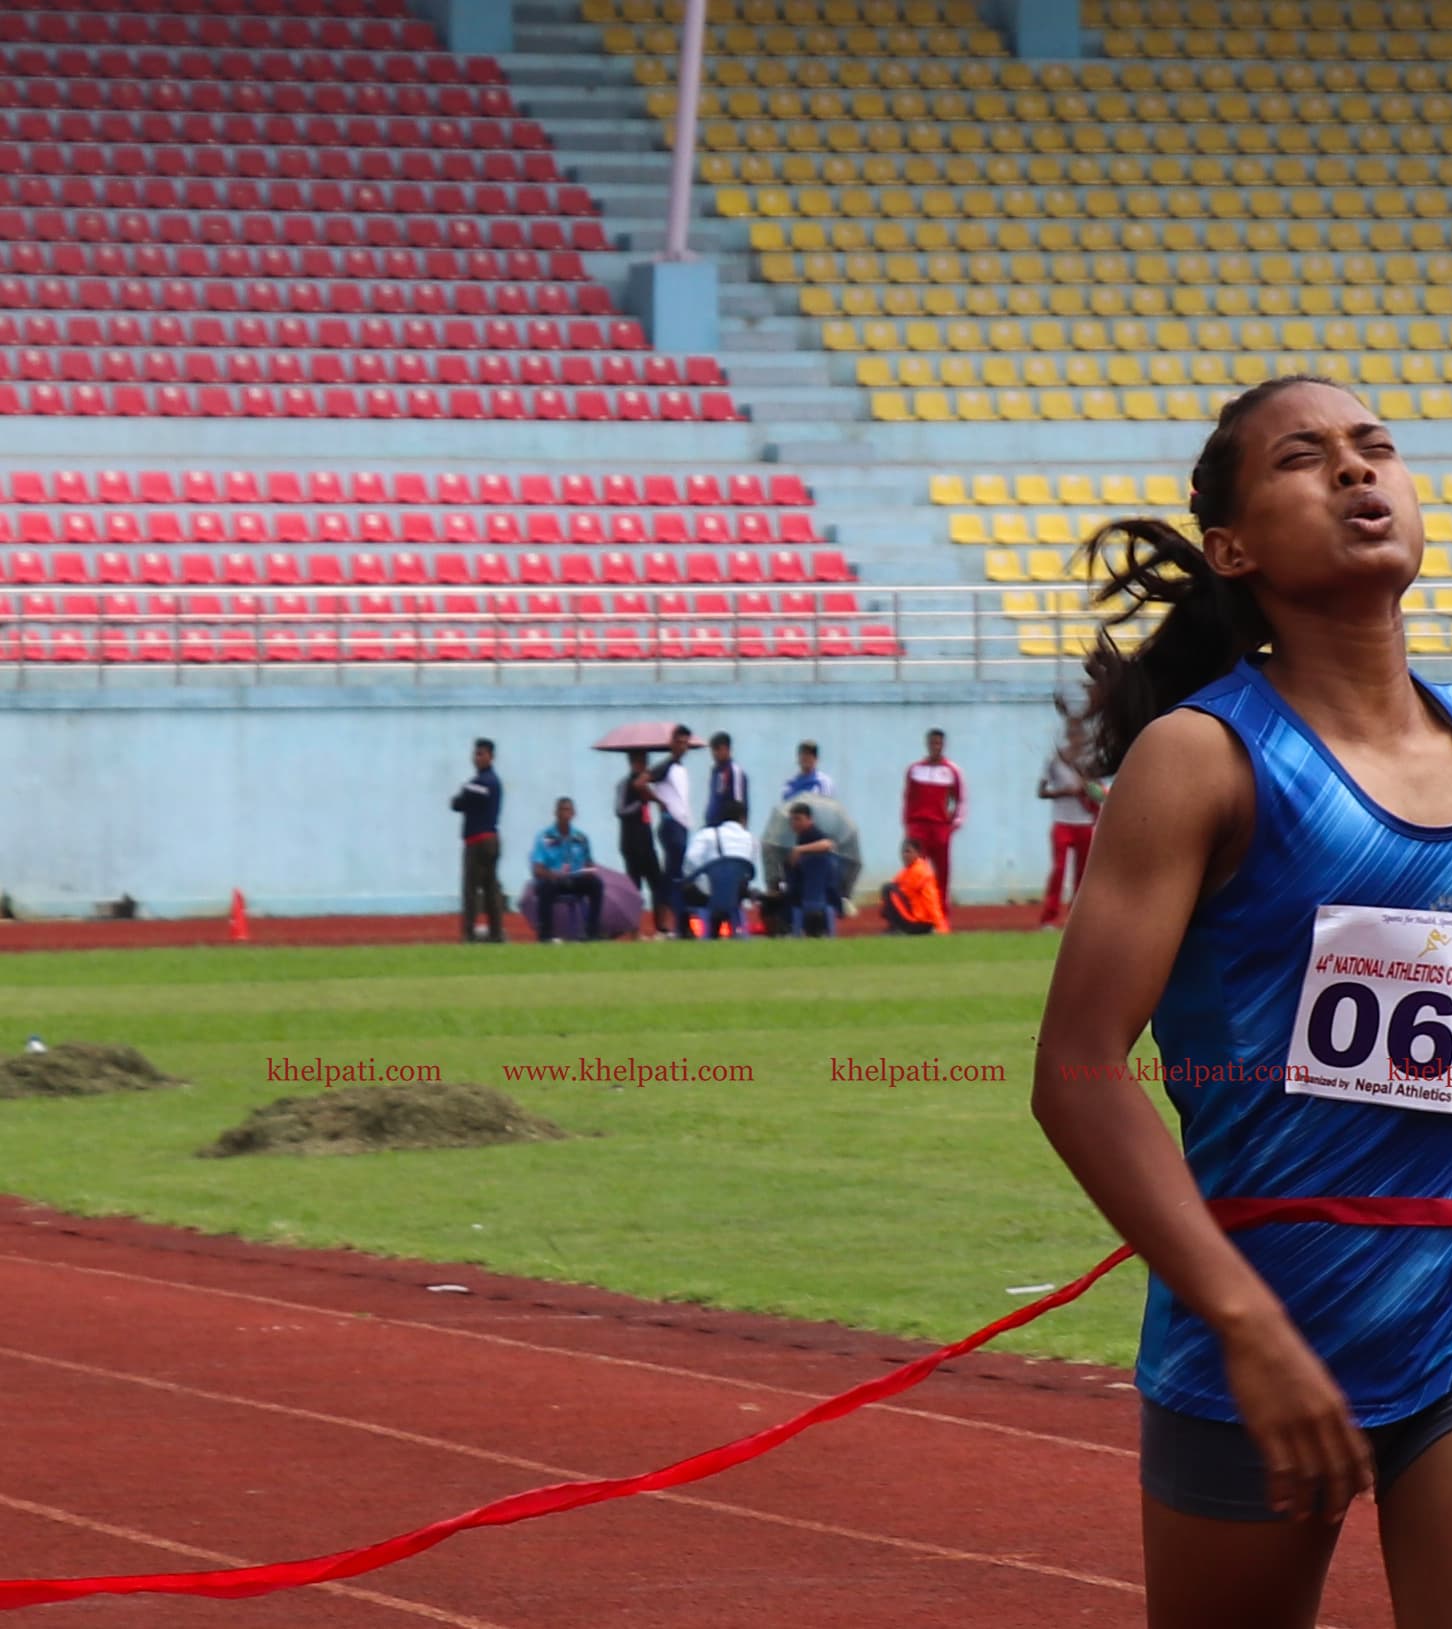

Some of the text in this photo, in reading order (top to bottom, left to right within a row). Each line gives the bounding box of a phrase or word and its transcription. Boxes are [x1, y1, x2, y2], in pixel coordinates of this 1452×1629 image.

[1333, 956, 1385, 978] NATIONAL
[1386, 961, 1445, 984] ATHLETICS
[1355, 1078, 1393, 1096] Nepal
[1395, 1083, 1452, 1103] Athletics
